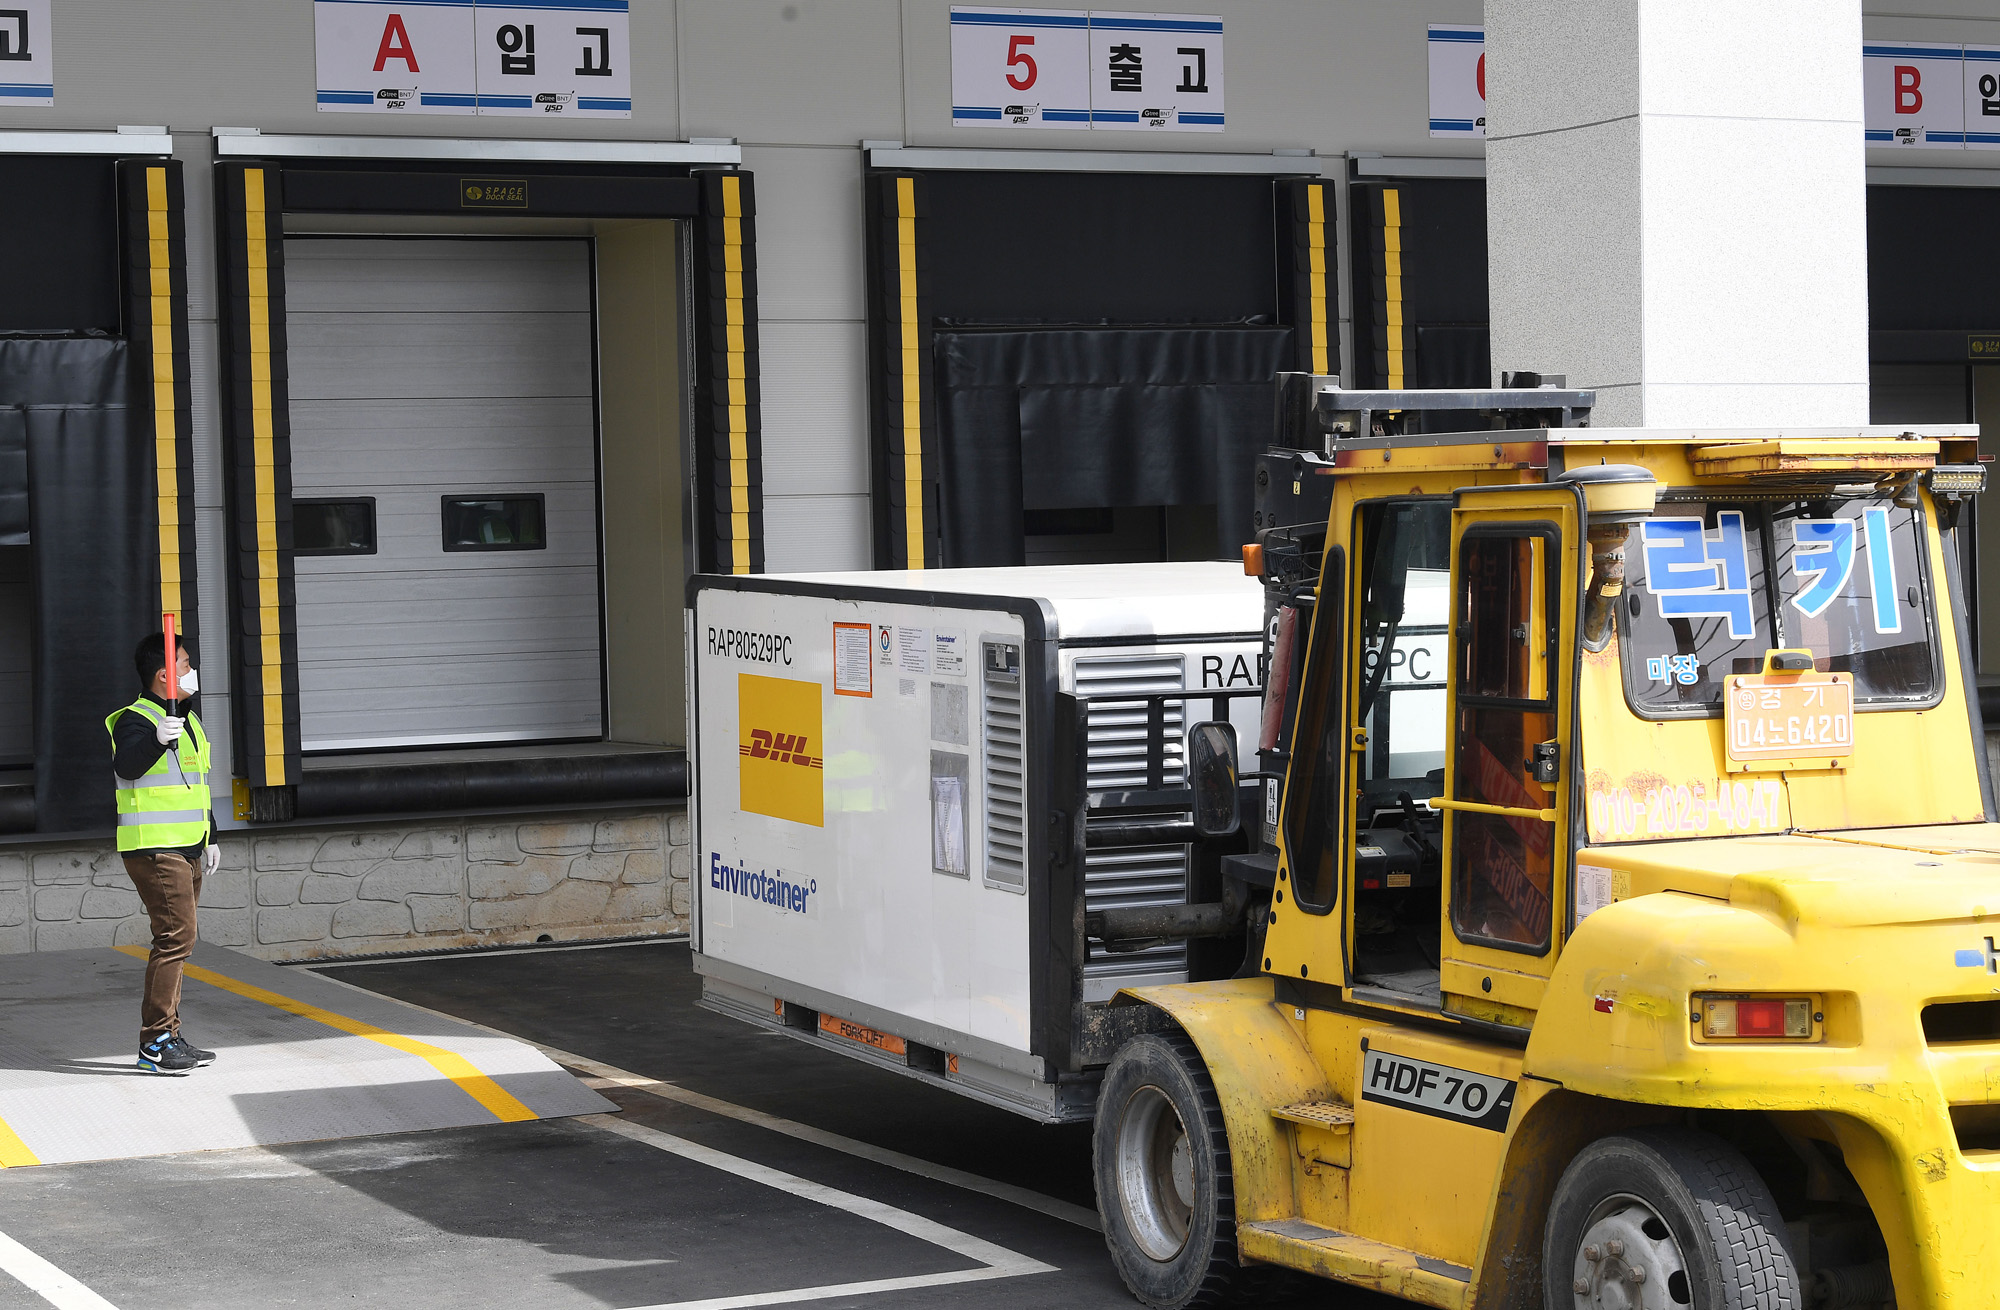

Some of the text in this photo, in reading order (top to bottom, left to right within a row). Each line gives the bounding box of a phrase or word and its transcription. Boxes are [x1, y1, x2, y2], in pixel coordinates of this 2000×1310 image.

[372, 13, 420, 73] A
[1005, 34, 1038, 91] 5
[1894, 65, 1923, 114] B
[485, 186, 524, 195] SPACE
[1640, 506, 1902, 640] 럭키
[708, 627, 792, 666] RAP80529PC
[1647, 653, 1700, 686] 마장
[750, 728, 812, 767] DHL
[1736, 714, 1848, 747] 04노6420
[1592, 780, 1780, 837] 010-2025-4847
